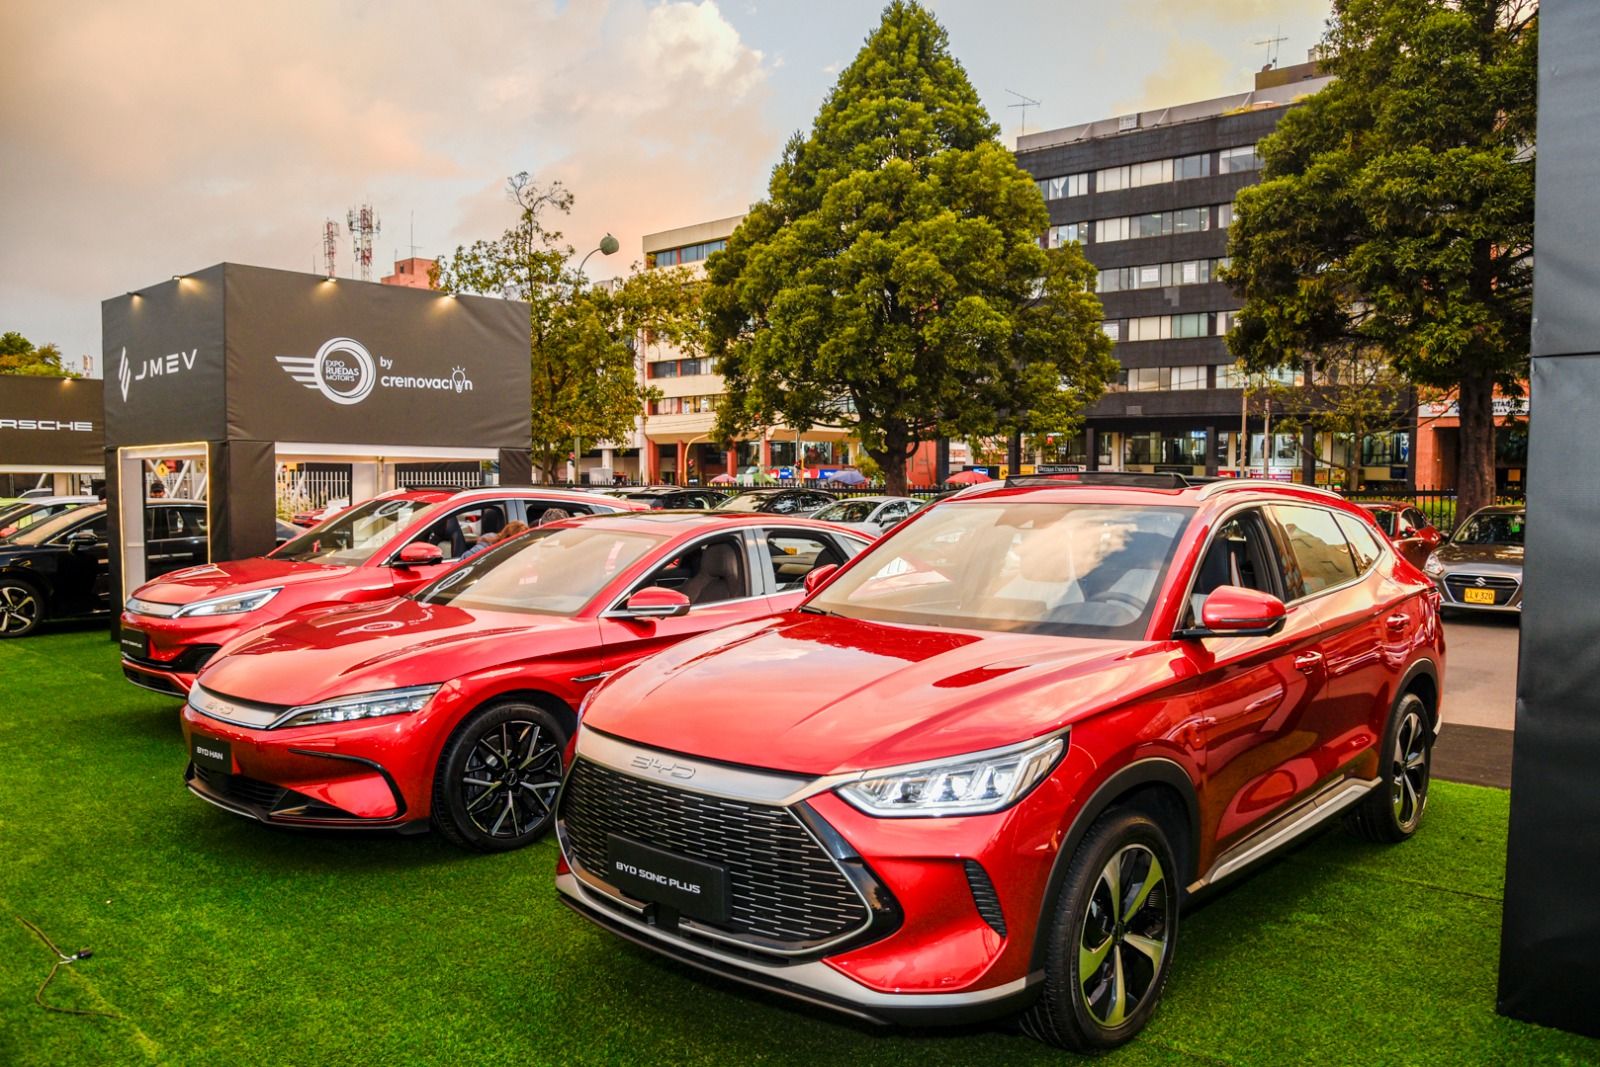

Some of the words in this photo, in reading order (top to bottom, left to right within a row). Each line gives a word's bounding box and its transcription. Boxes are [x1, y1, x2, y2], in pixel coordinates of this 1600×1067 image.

[135, 348, 198, 380] JMEV
[325, 359, 345, 368] EXPO
[379, 356, 393, 370] by
[325, 367, 360, 376] RUEDAS
[196, 746, 210, 757] BYD
[209, 750, 224, 760] HAN
[630, 755, 697, 779] BYD
[615, 861, 638, 876] BYD
[638, 868, 668, 885] SONG
[668, 878, 702, 894] PLUS
